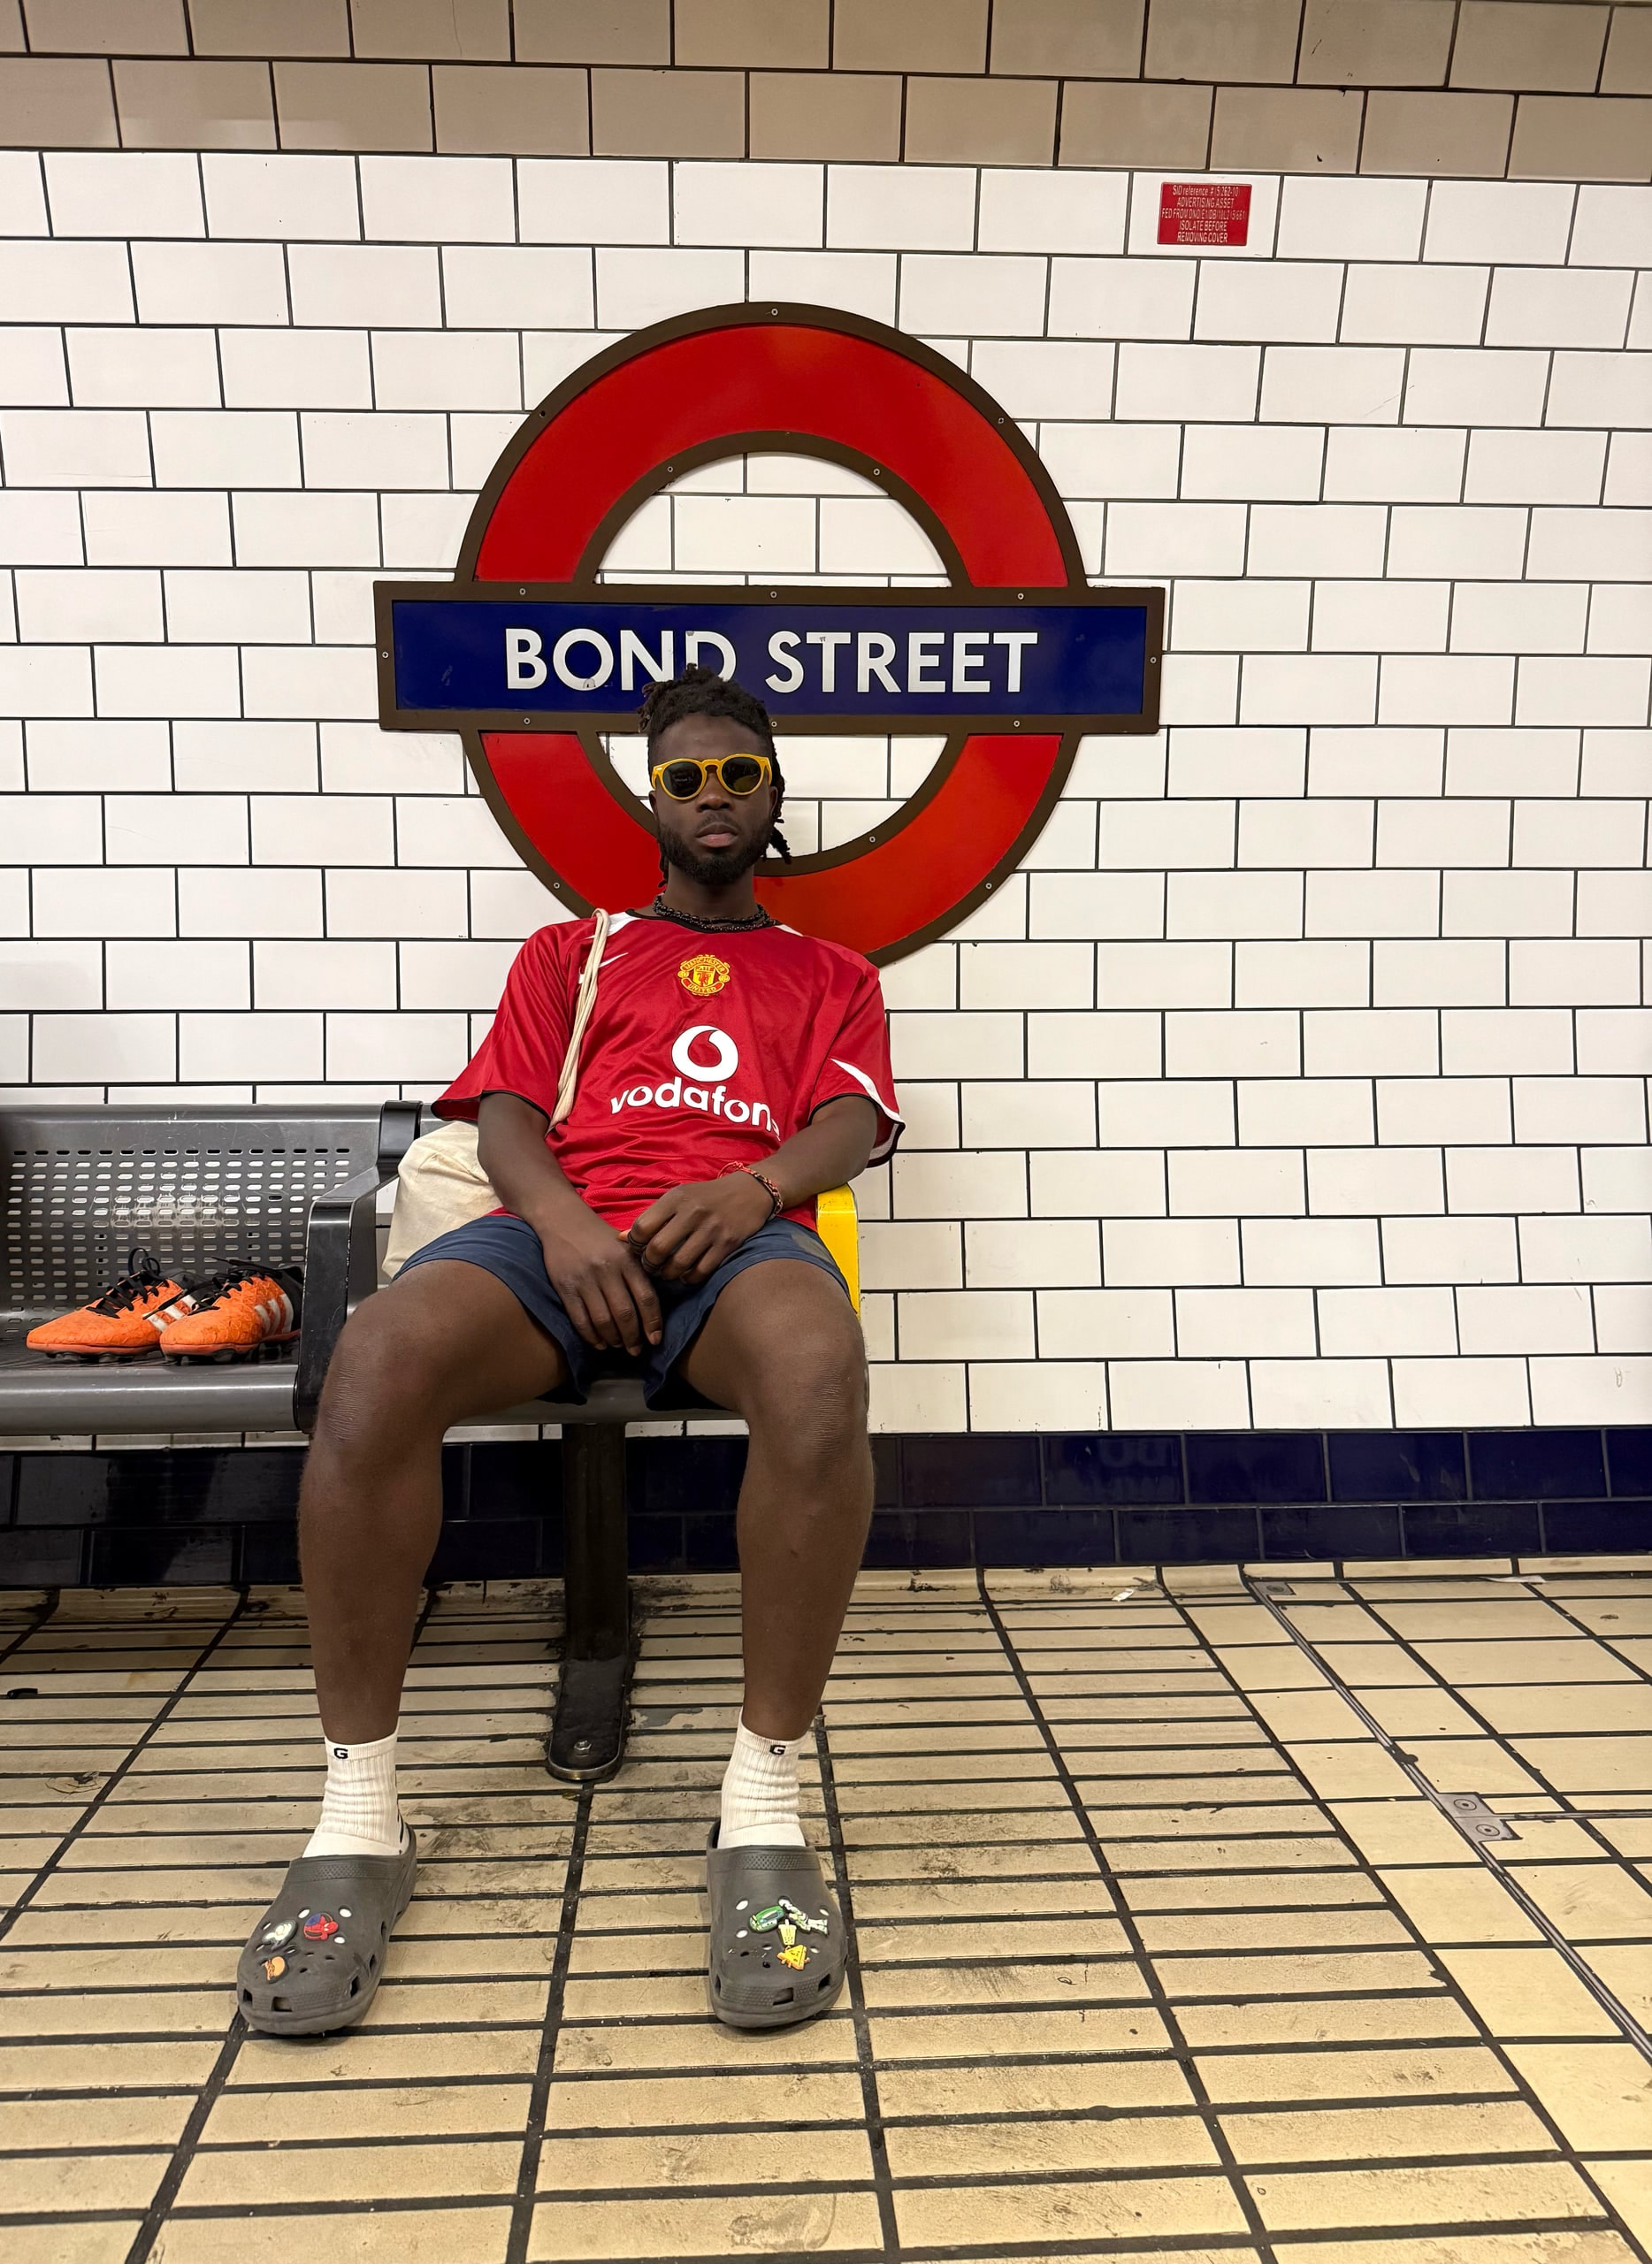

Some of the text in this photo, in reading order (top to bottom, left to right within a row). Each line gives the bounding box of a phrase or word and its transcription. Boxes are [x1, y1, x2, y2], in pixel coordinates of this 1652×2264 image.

[1183, 185, 1208, 196] reference
[1177, 197, 1235, 209] ADVERTISING ASSET
[1162, 208, 1173, 218] FED
[1173, 208, 1188, 219] FROM
[1179, 220, 1228, 232] ISOLATE BEFORE
[1176, 231, 1228, 243] REMOVING COVER
[505, 627, 1038, 693] BOND STREET
[684, 957, 726, 973] MANCHESTER
[688, 983, 717, 993] UNITED
[333, 1747, 348, 1760] G
[769, 1744, 786, 1755] G
